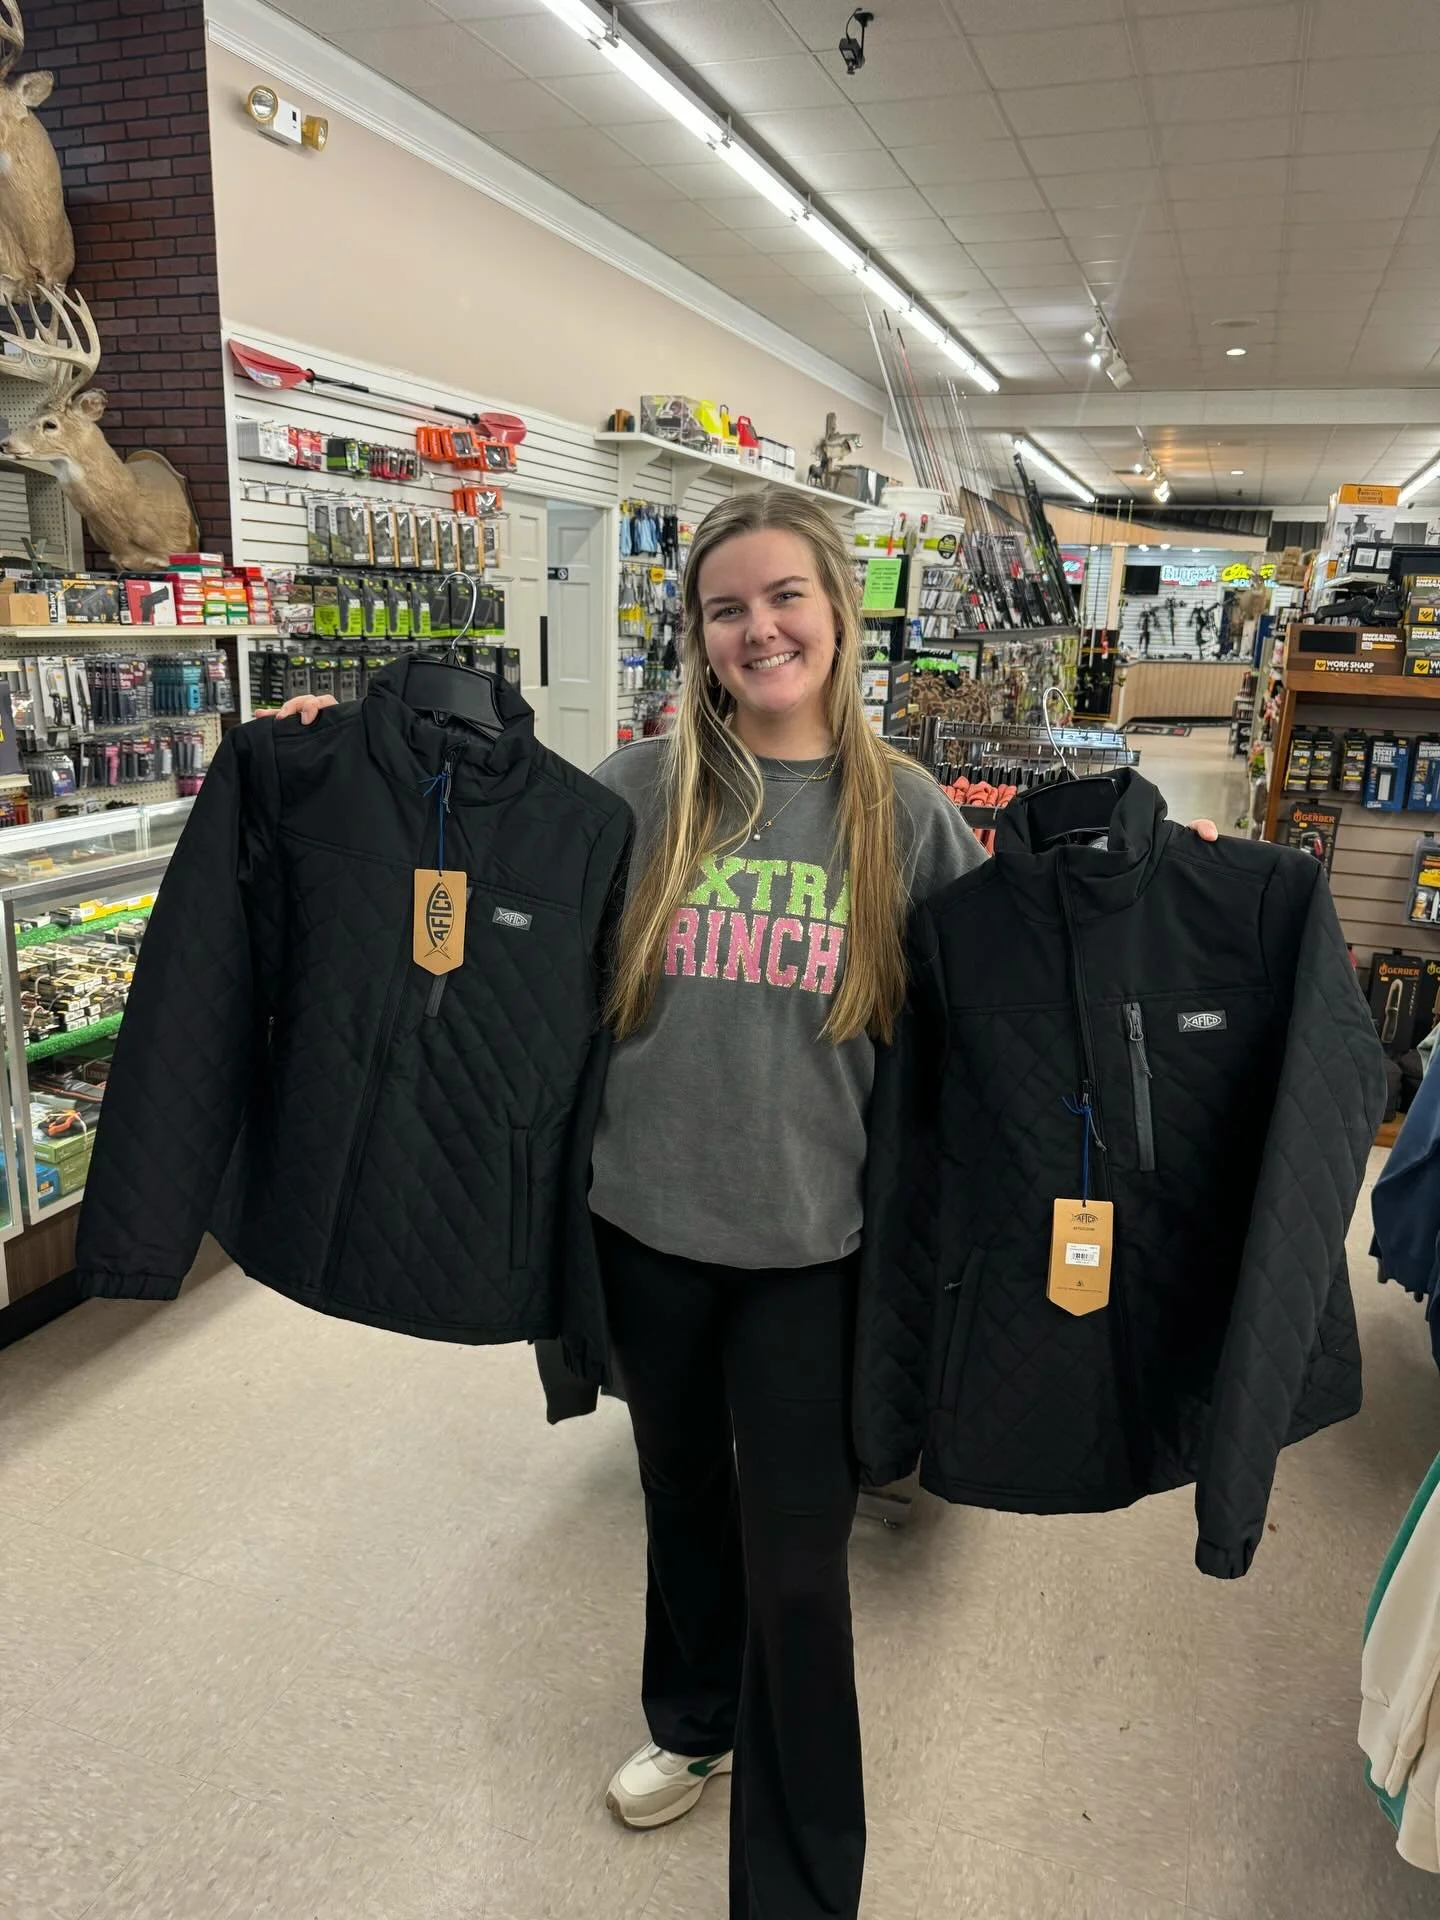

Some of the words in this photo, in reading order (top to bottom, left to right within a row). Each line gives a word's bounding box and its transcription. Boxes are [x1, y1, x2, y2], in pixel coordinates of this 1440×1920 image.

[1326, 660, 1350, 668] WORK
[1350, 661, 1375, 669] SHARP
[1302, 813, 1336, 824] GERBER
[1387, 967, 1421, 977] GERBER
[1191, 1014, 1218, 1028] AFTCO
